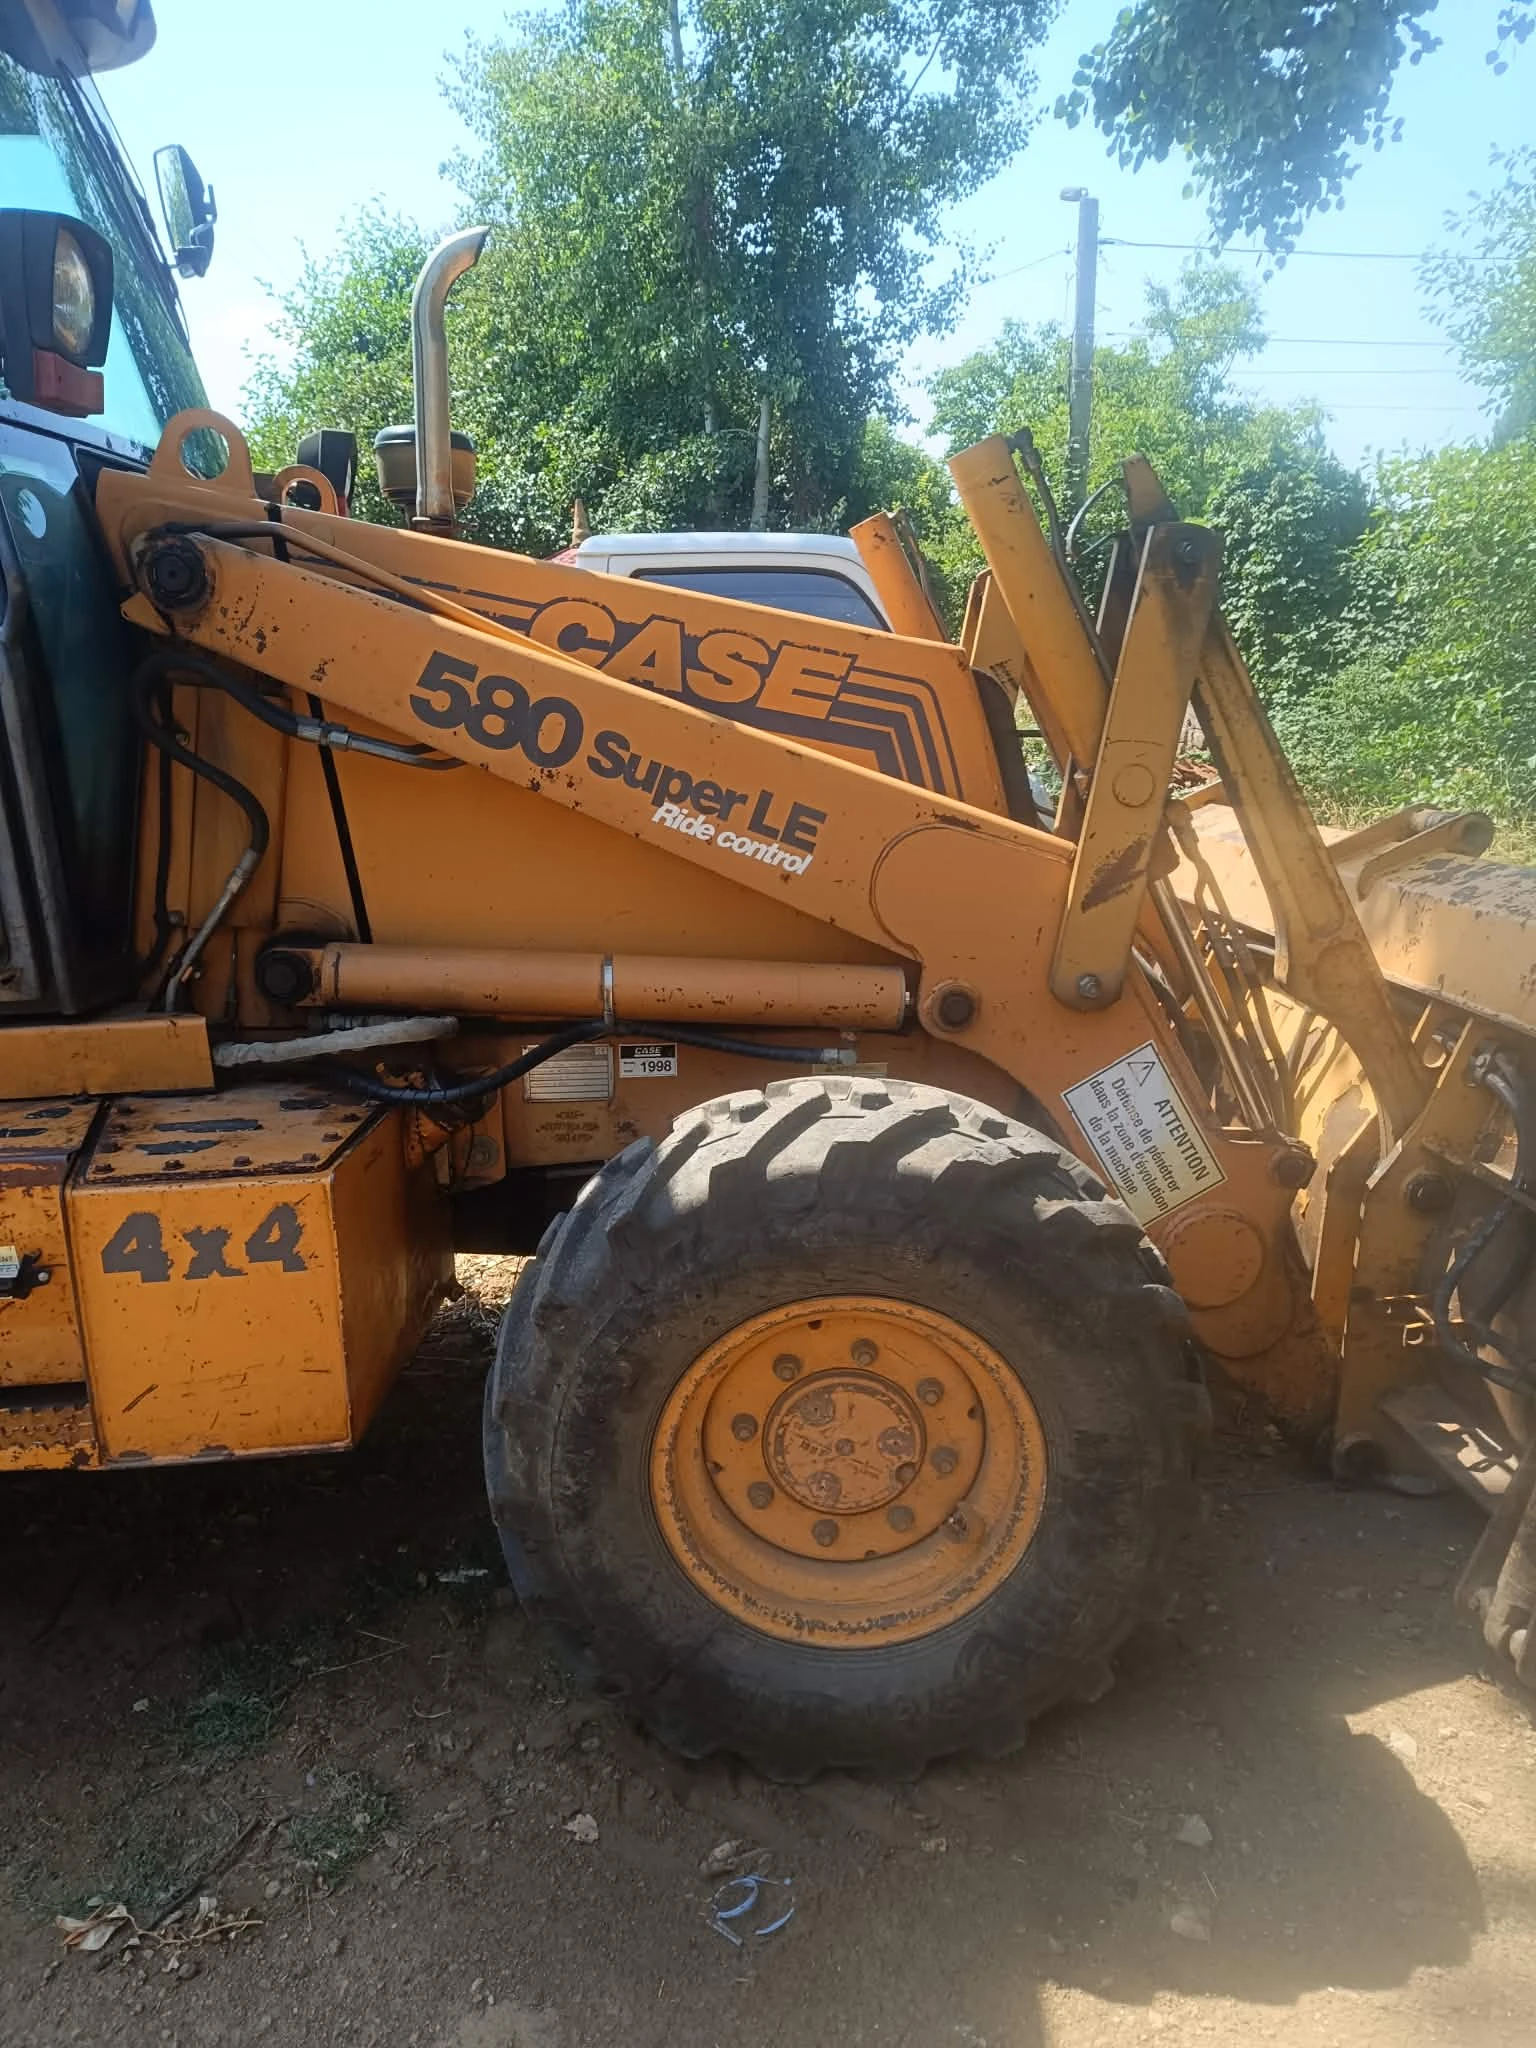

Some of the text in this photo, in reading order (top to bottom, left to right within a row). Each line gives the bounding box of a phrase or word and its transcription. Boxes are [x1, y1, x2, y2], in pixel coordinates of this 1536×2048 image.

[529, 597, 858, 721] CASE
[410, 649, 828, 854] 580 Super LE
[651, 801, 815, 876] Ride control
[640, 1060, 673, 1073] 1998
[1089, 1079, 1170, 1213] dans la zone d'évolution
[1089, 1116, 1139, 1195] de la machine
[1111, 1077, 1181, 1193] Défense de pénétrer
[1154, 1098, 1211, 1182] ATTENTION
[101, 1202, 309, 1284] 4x4
